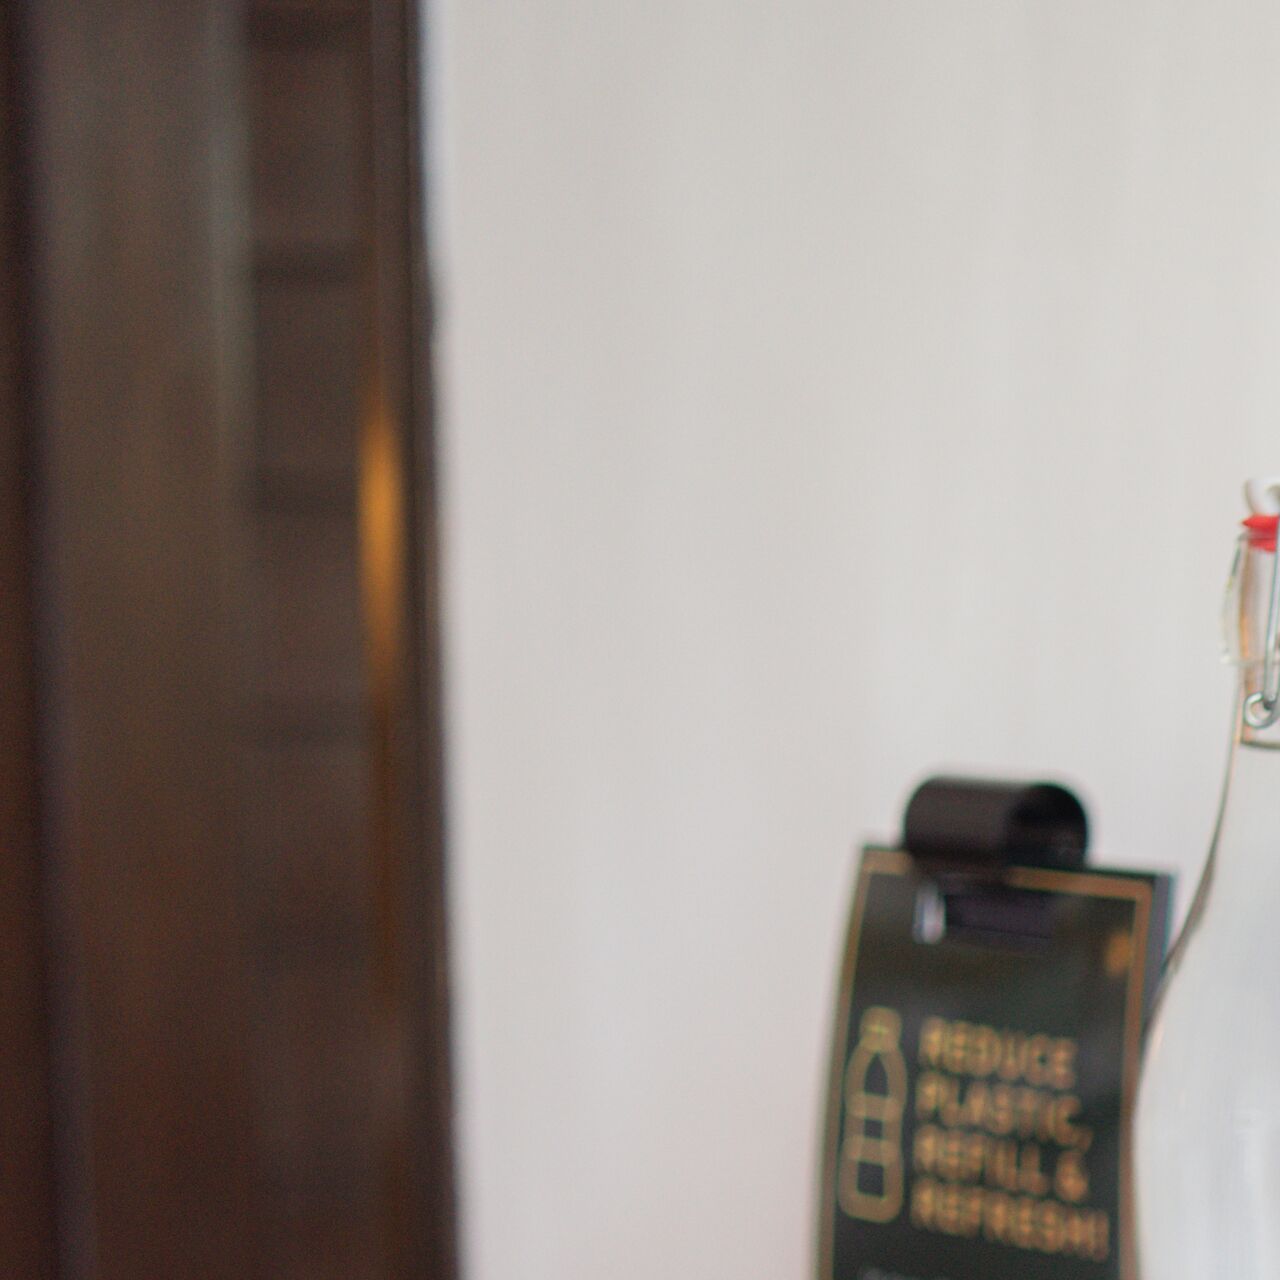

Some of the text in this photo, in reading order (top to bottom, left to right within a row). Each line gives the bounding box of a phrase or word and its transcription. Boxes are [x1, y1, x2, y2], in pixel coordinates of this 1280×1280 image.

[919, 1017, 1077, 1090] REDUCE
[912, 1124, 1089, 1201] REFILL &
[909, 1177, 1109, 1263] REFRESH!
